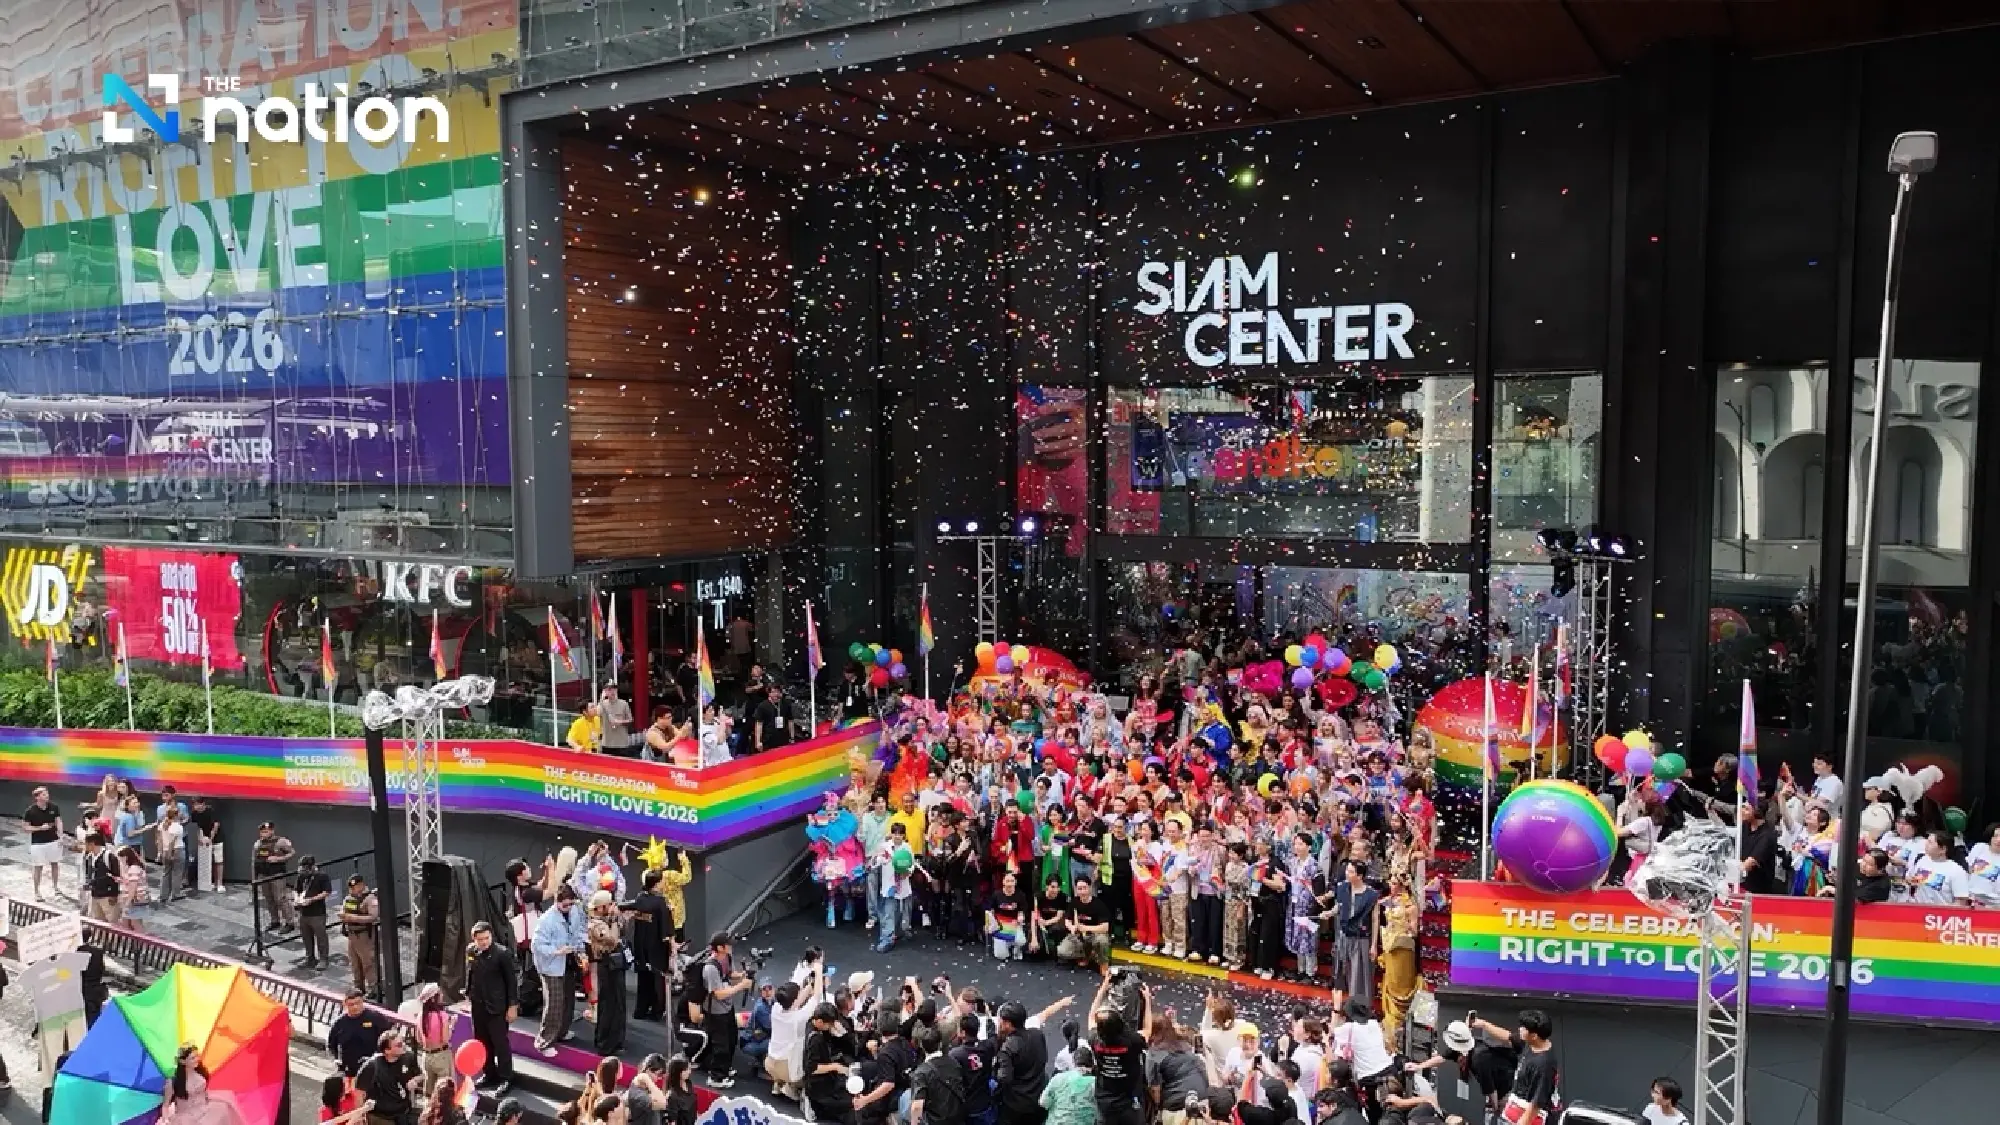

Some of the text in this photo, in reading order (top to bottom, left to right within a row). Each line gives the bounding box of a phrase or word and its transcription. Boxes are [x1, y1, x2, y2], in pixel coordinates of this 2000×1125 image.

[113, 183, 327, 303] LOVE
[1133, 250, 1280, 316] SIAM
[168, 309, 283, 375] 2026
[1184, 301, 1415, 367] CENTER
[208, 437, 274, 463] CENTER
[384, 560, 473, 607] KFC
[285, 768, 326, 787] RIGHT
[543, 765, 567, 780] THE
[544, 783, 699, 824] RIGHT TO LOVE 2026
[1501, 907, 1557, 931] THE
[1924, 914, 1972, 931] SIAM
[1939, 931, 2000, 948] CENTE
[1500, 936, 1615, 967] RIGHT
[1620, 947, 1656, 966] TO
[1776, 953, 1876, 986] 206
